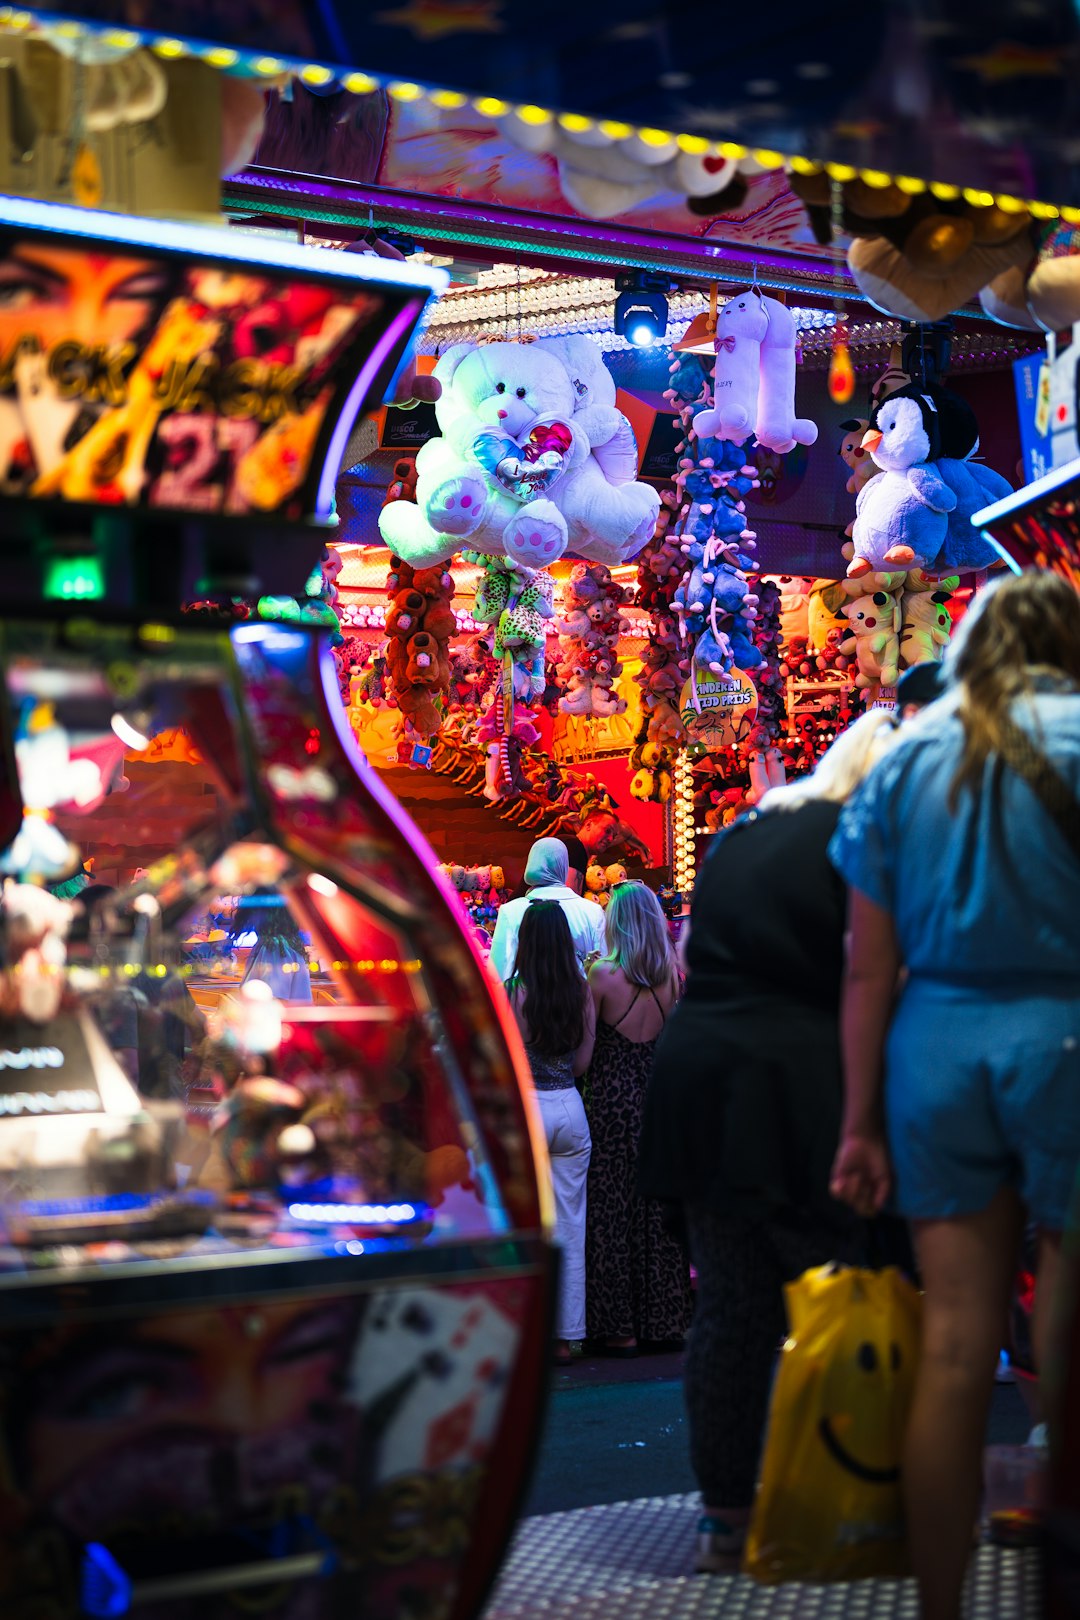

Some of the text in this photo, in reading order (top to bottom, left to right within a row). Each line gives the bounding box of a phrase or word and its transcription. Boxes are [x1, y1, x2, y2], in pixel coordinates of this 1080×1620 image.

[513, 465, 518, 475] I
[520, 472, 548, 483] Love
[721, 693, 751, 706] PRIJS
